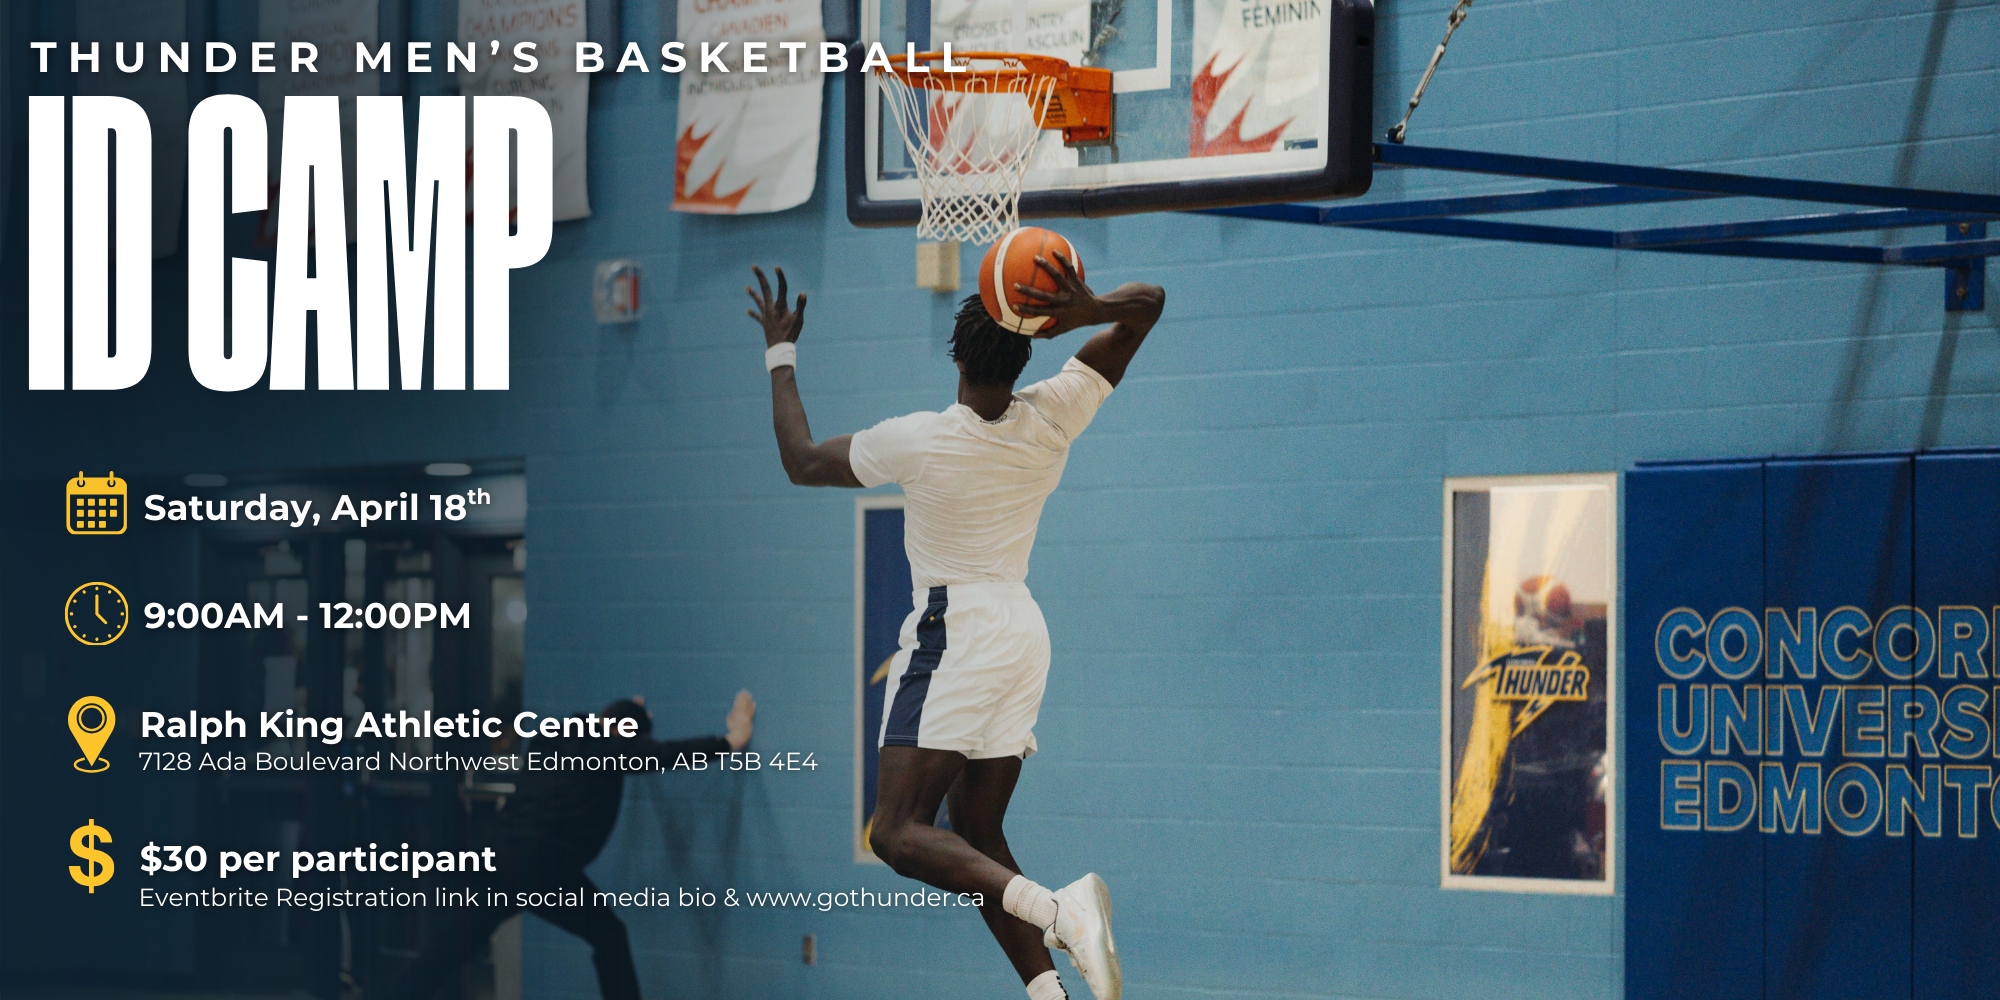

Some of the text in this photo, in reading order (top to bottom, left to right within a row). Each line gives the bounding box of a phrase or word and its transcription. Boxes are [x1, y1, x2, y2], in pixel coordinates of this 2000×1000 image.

[1493, 656, 1588, 698] THUNDER
[1655, 605, 2000, 681] CONCOR
[1661, 760, 2000, 838] EDMONT
